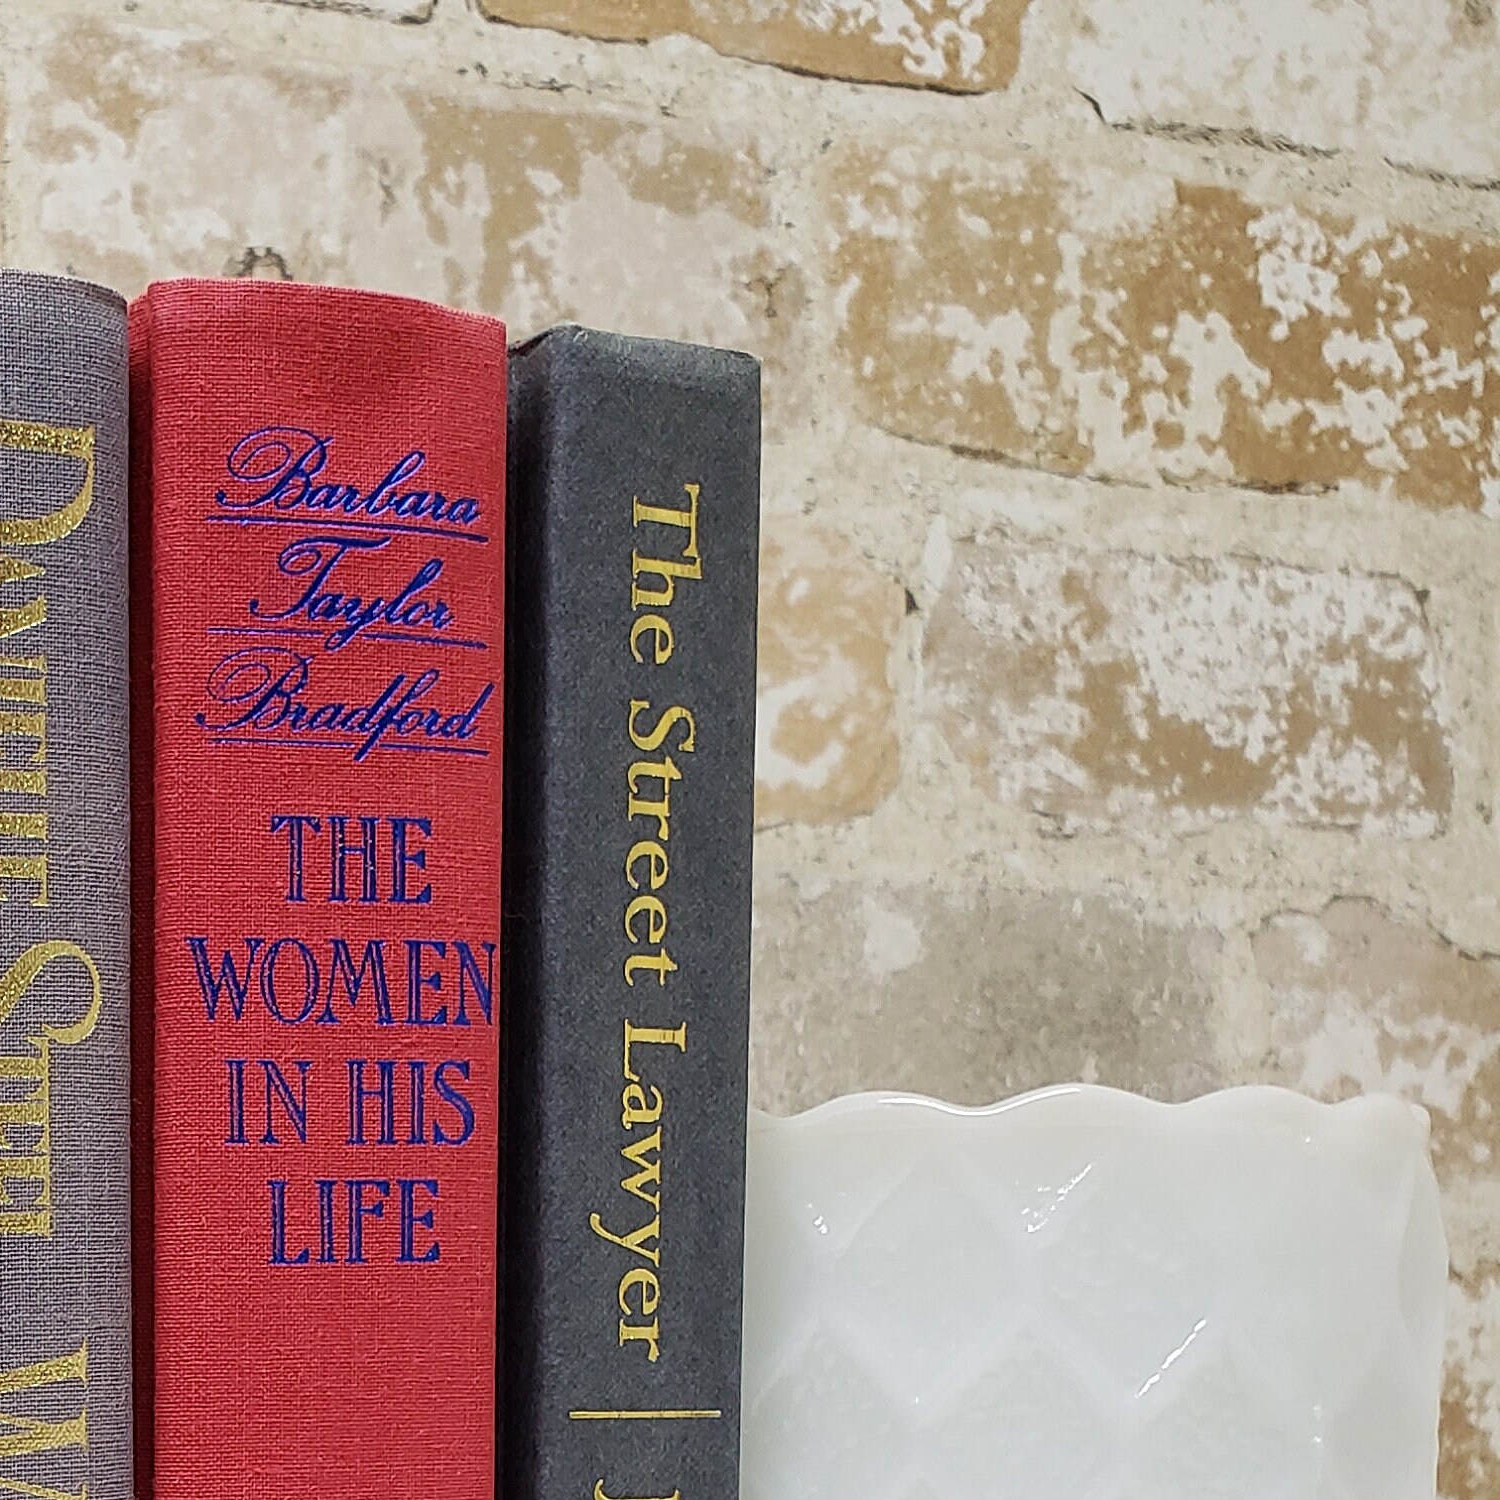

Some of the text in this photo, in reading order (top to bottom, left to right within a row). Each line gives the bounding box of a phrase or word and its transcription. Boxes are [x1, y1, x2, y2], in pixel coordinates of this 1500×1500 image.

[216, 426, 482, 524] Barbara
[250, 537, 456, 652] Taylor
[195, 646, 495, 762] Bradford
[270, 815, 433, 906] THE
[589, 483, 703, 1363] The Street Lawyer
[187, 936, 497, 1027] WOMEN
[224, 1059, 477, 1146] IN HIS
[267, 1178, 441, 1265] LIFE
